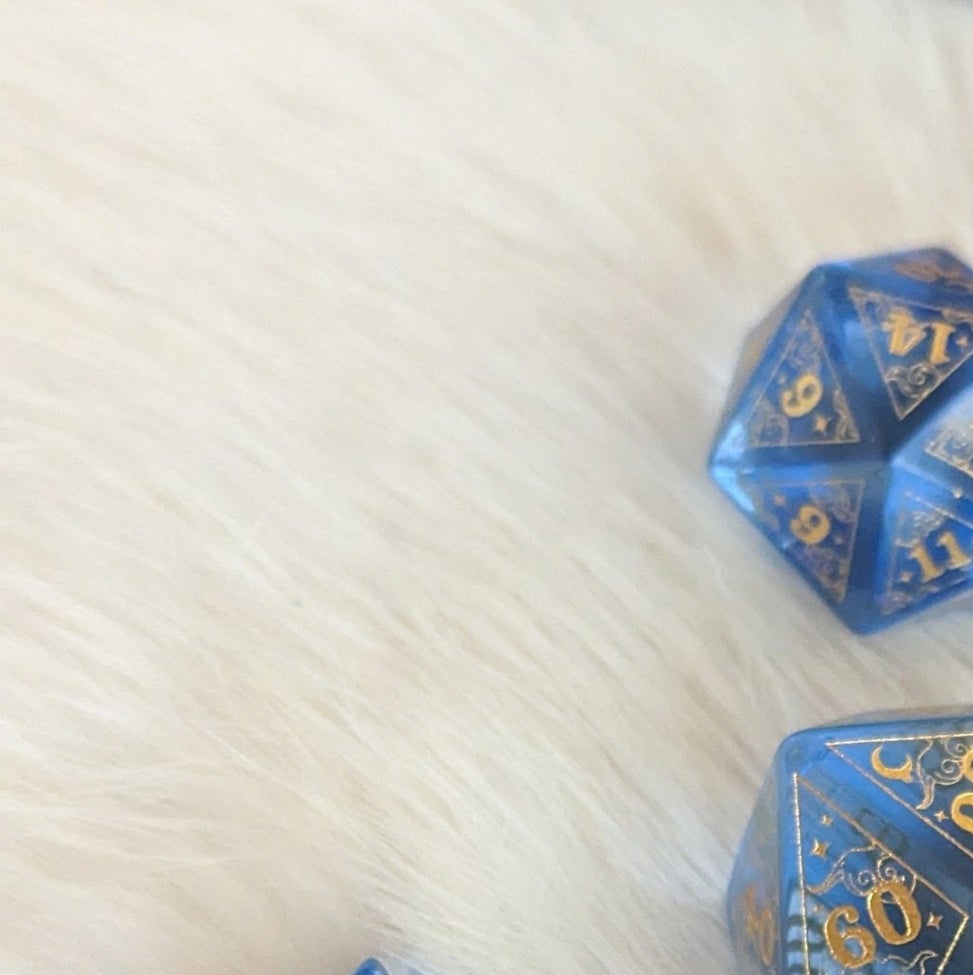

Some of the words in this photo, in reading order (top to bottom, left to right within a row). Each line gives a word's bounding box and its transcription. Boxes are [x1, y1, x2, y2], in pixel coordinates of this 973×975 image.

[881, 308, 956, 364] 14
[909, 532, 972, 582] 11
[824, 878, 921, 969] 60
